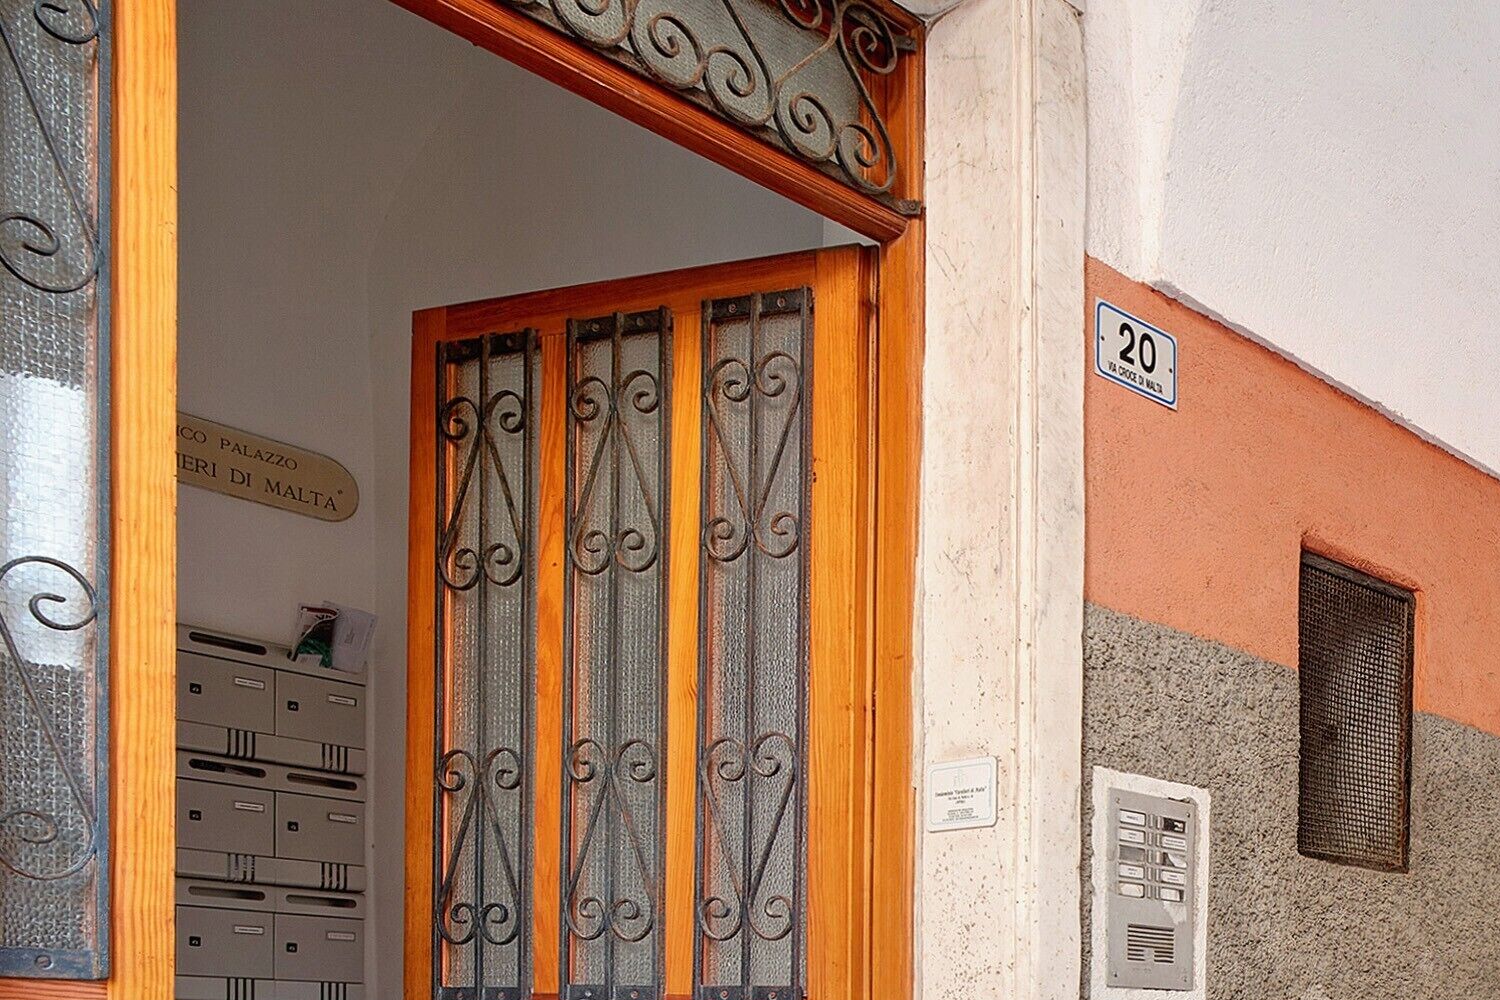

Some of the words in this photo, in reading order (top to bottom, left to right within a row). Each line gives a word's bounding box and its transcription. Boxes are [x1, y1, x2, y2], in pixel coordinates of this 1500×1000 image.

[1108, 360, 1118, 373] VIA
[1119, 322, 1156, 374] 20
[220, 437, 298, 471] PALAZZO
[229, 467, 251, 488] DI
[264, 477, 338, 512] MALTA
